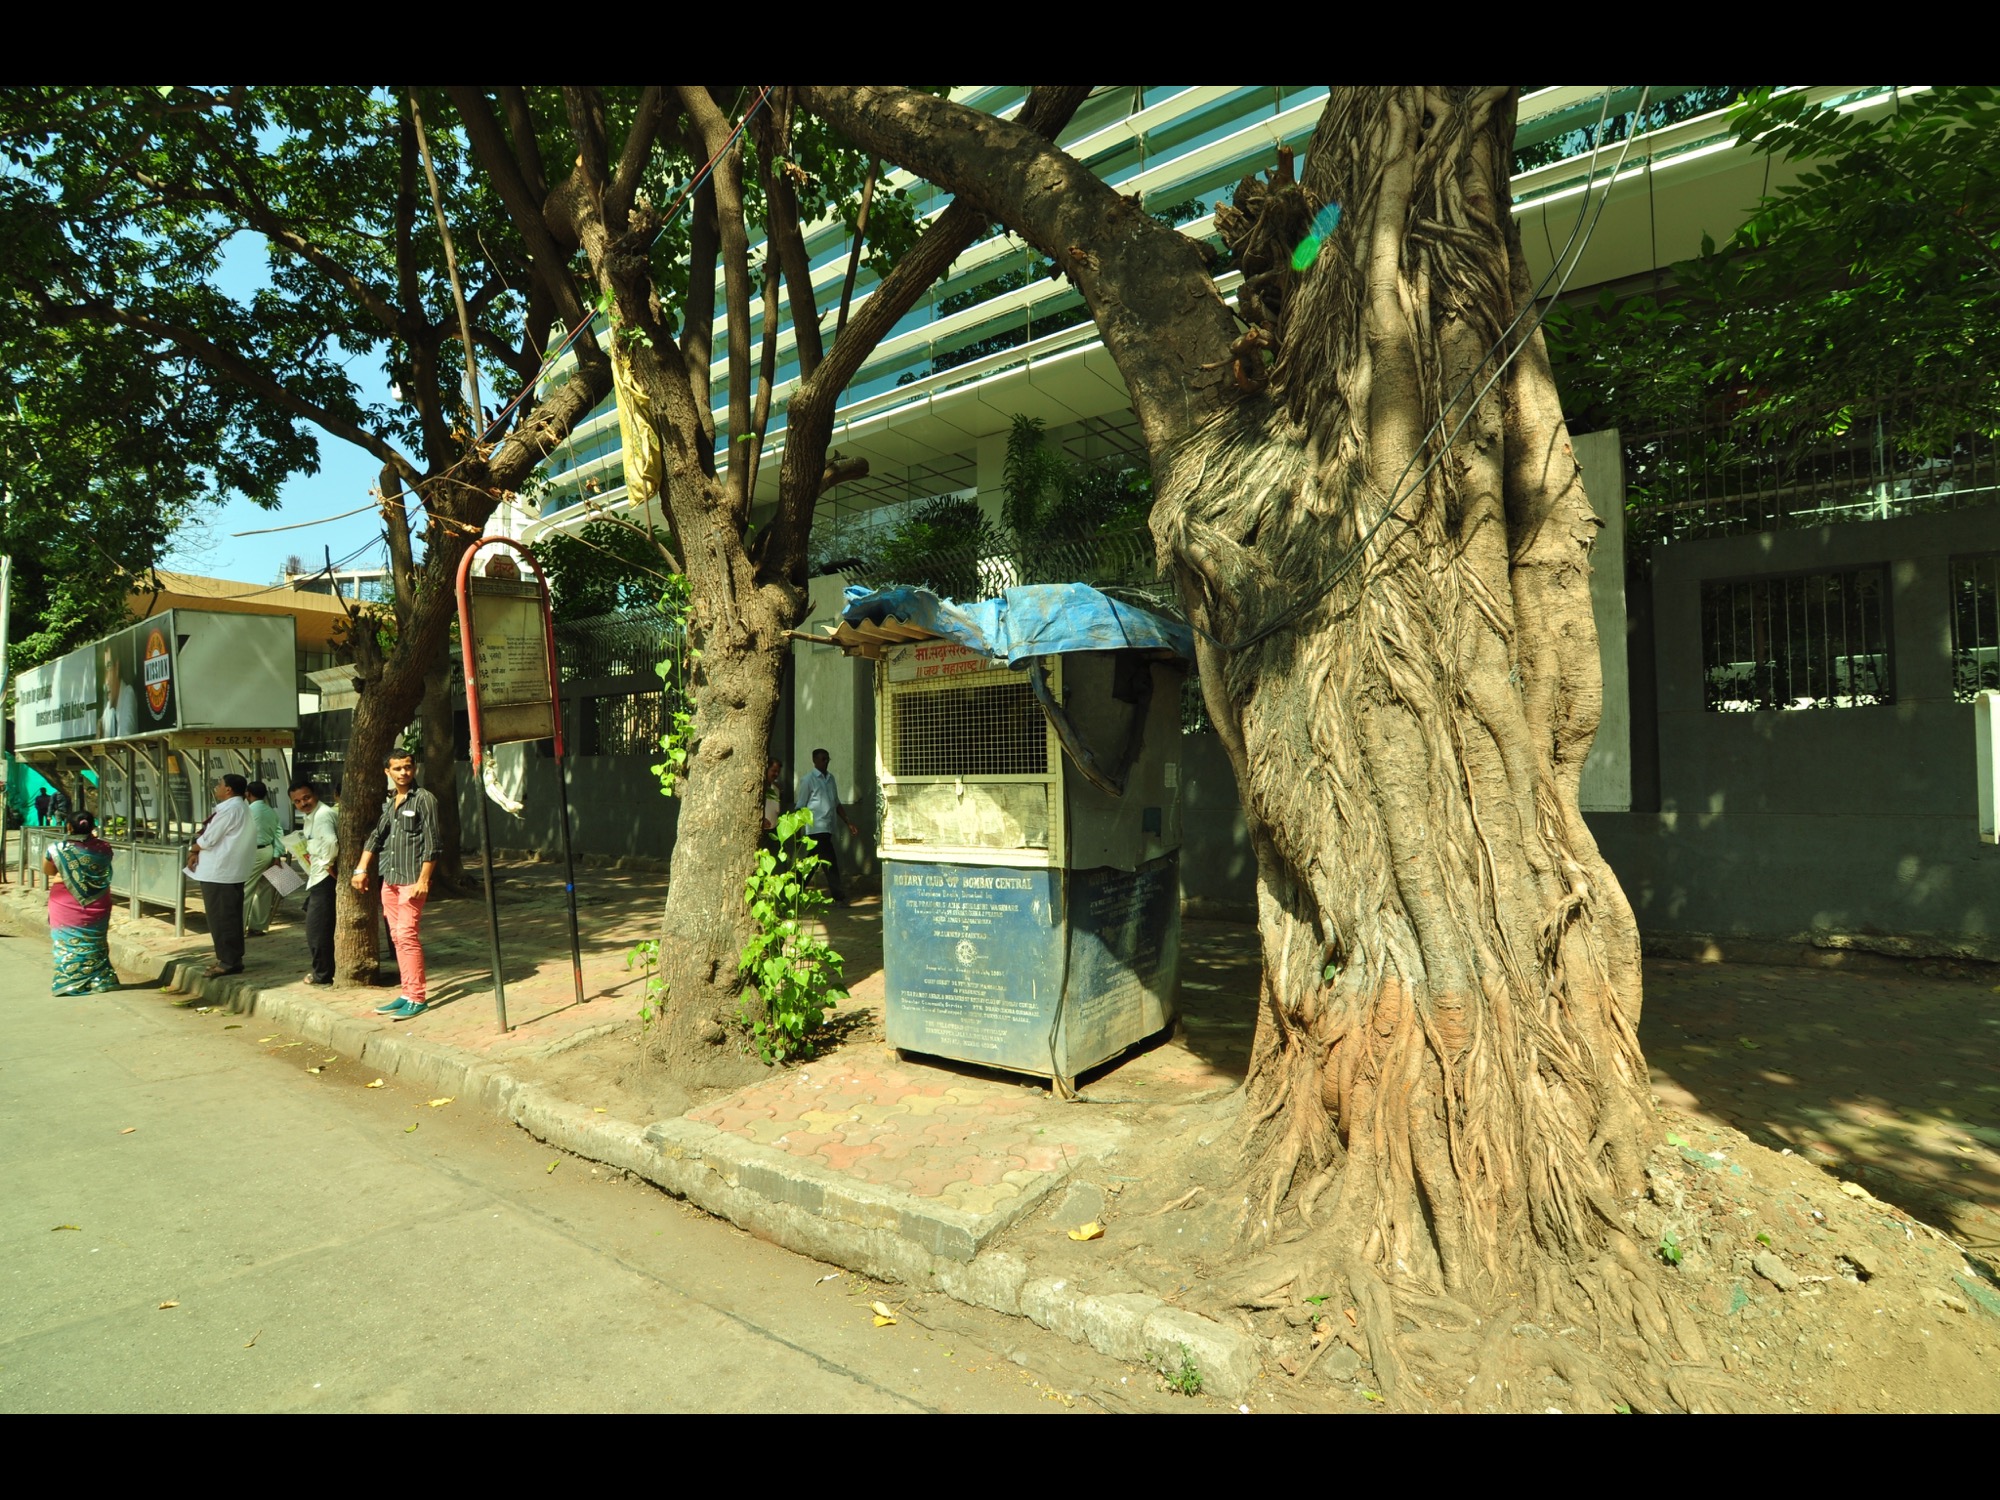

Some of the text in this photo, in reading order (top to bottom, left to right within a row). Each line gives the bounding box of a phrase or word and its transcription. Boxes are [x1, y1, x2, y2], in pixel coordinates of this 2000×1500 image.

[893, 874, 1033, 890] ROTARY CLUB OF BOMBAY CENTRAL
